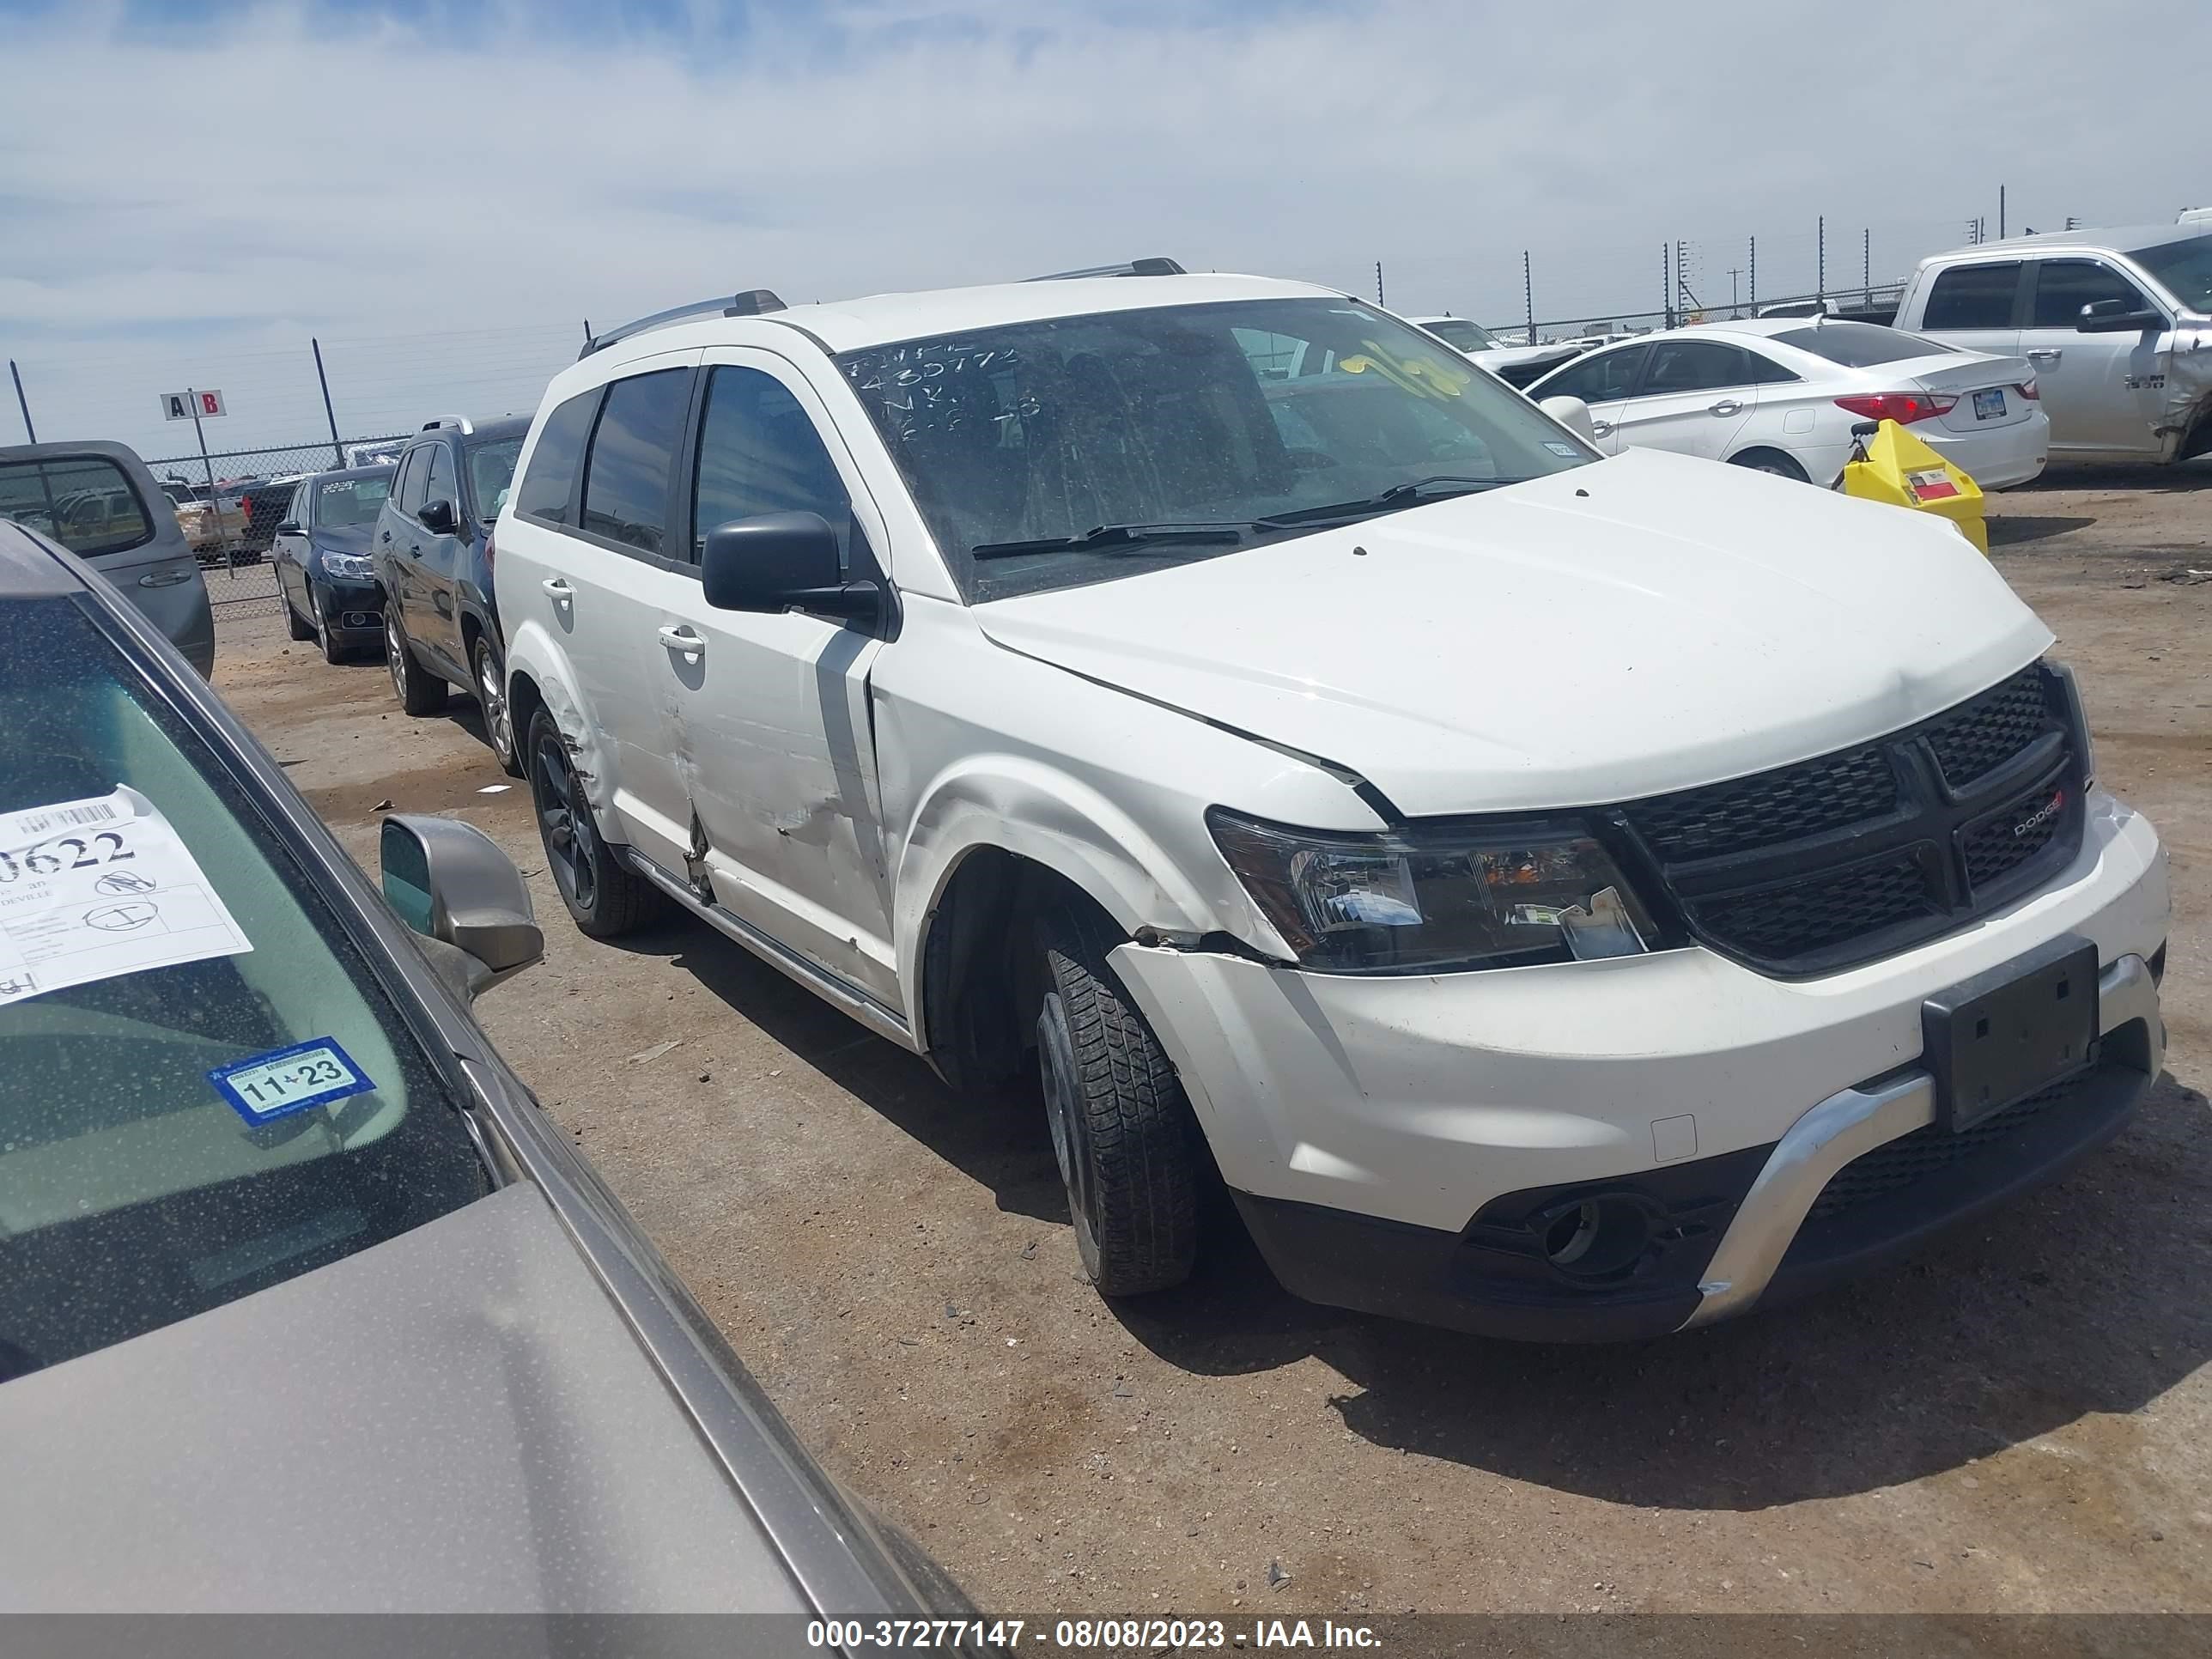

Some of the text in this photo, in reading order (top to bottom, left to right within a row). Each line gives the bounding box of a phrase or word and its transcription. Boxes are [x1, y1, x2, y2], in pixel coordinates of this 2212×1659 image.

[170, 393, 218, 416] A B
[2014, 797, 2061, 837] DODGE
[243, 1076, 287, 1102] 11
[297, 1060, 342, 1085] 23
